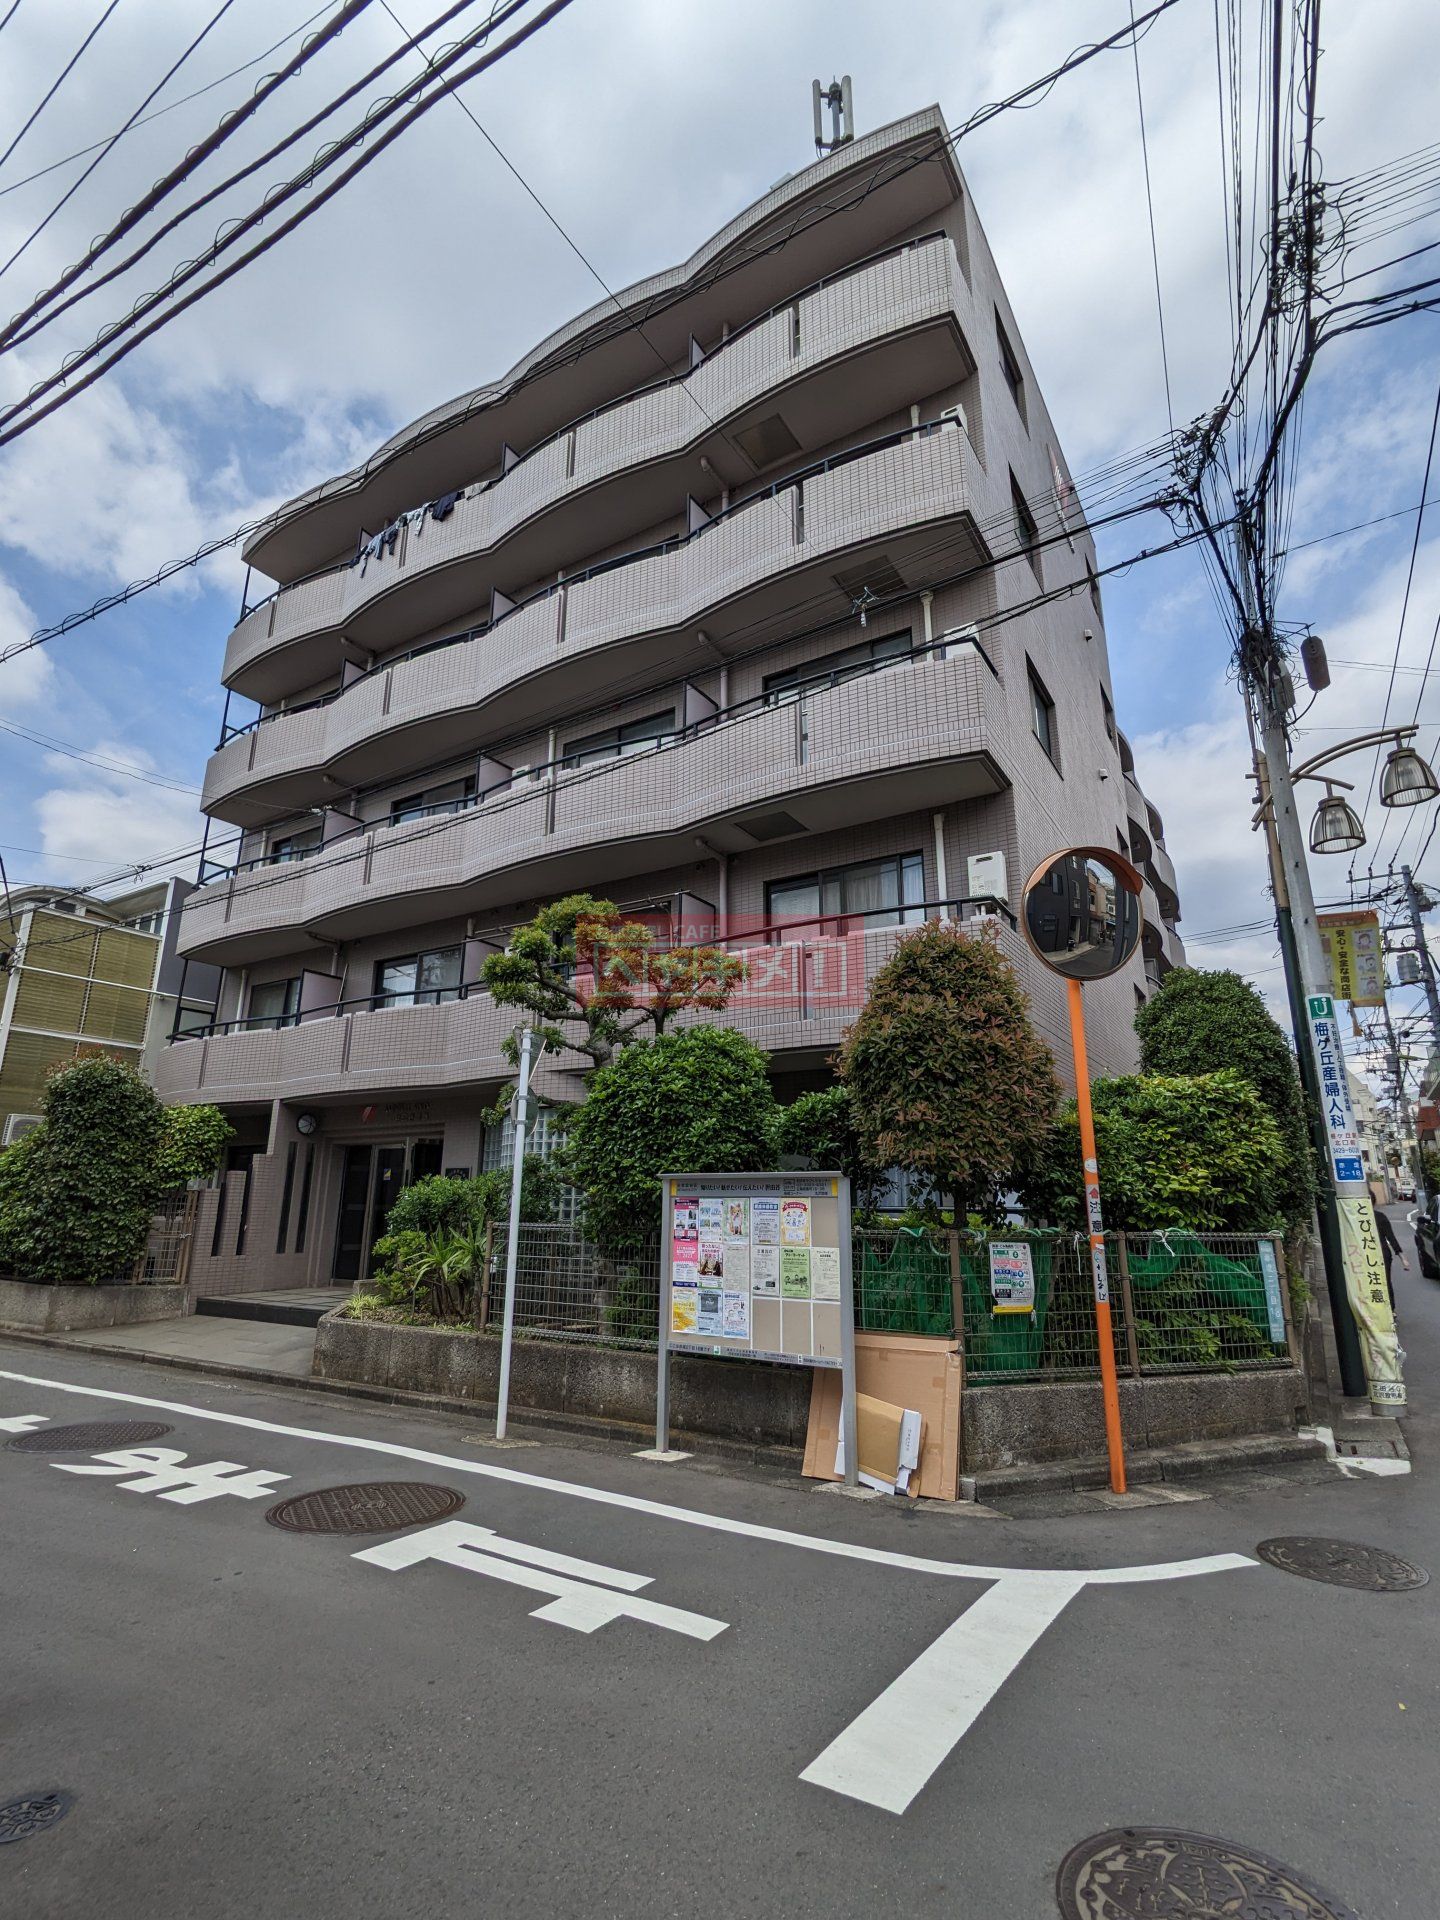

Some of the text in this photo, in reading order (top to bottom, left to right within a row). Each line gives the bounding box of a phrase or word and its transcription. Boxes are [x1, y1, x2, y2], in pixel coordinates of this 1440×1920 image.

[1090, 1201, 1103, 1233] 注意
[1356, 1202, 1386, 1303] とびだし注意
